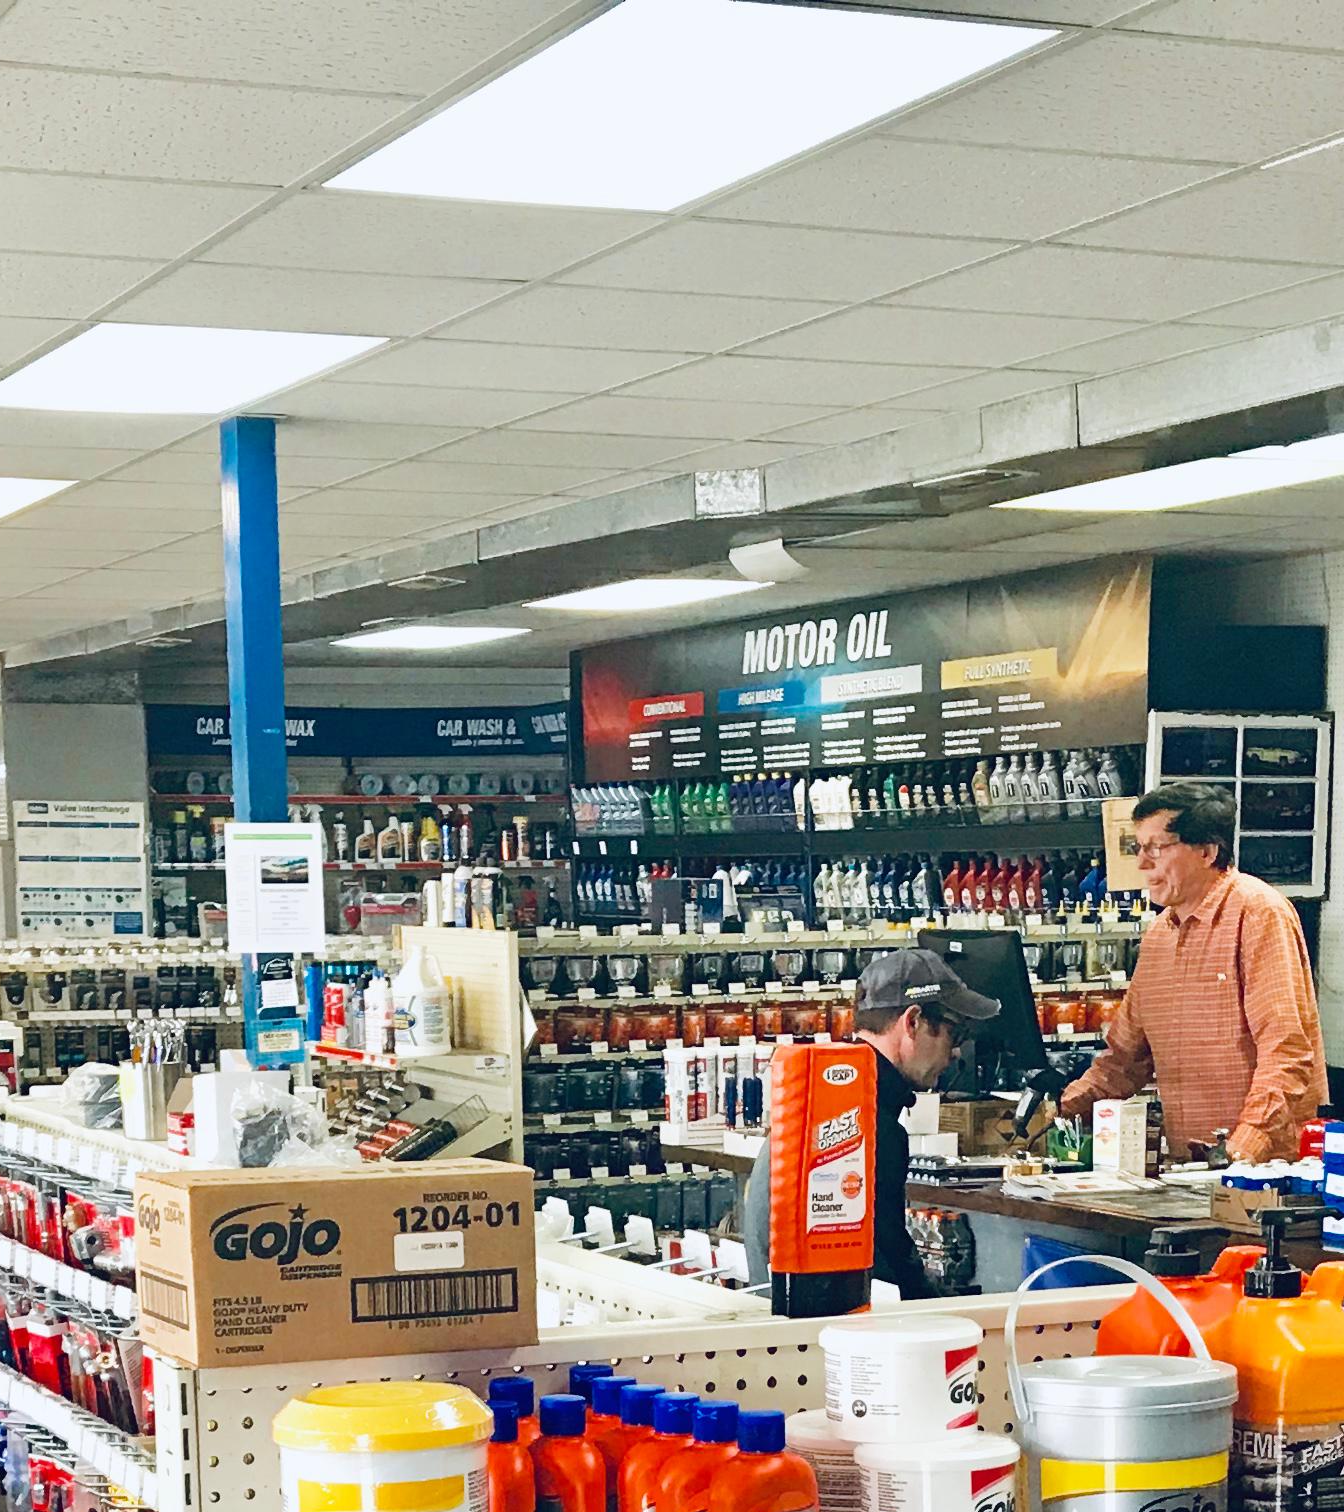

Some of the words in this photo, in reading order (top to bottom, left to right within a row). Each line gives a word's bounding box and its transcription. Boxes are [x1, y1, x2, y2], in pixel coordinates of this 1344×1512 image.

[742, 618, 837, 674] MOTOR
[847, 610, 892, 662] OIL
[196, 717, 224, 735] CAR
[285, 719, 316, 737] WAX
[437, 719, 463, 737] CAR
[467, 718, 503, 736] WASH
[506, 718, 516, 735] &
[818, 1108, 859, 1140] FAST
[423, 1191, 470, 1203] REORDER
[472, 1191, 490, 1202] NO.
[812, 1192, 833, 1202] Hand
[393, 1202, 520, 1233] 1204-01
[811, 1203, 843, 1213] Cleaner
[213, 1317, 245, 1328] HAND
[246, 1314, 287, 1326] CLEANER
[213, 1326, 273, 1338] CARTRIDGES
[1302, 1436, 1344, 1464] FAST
